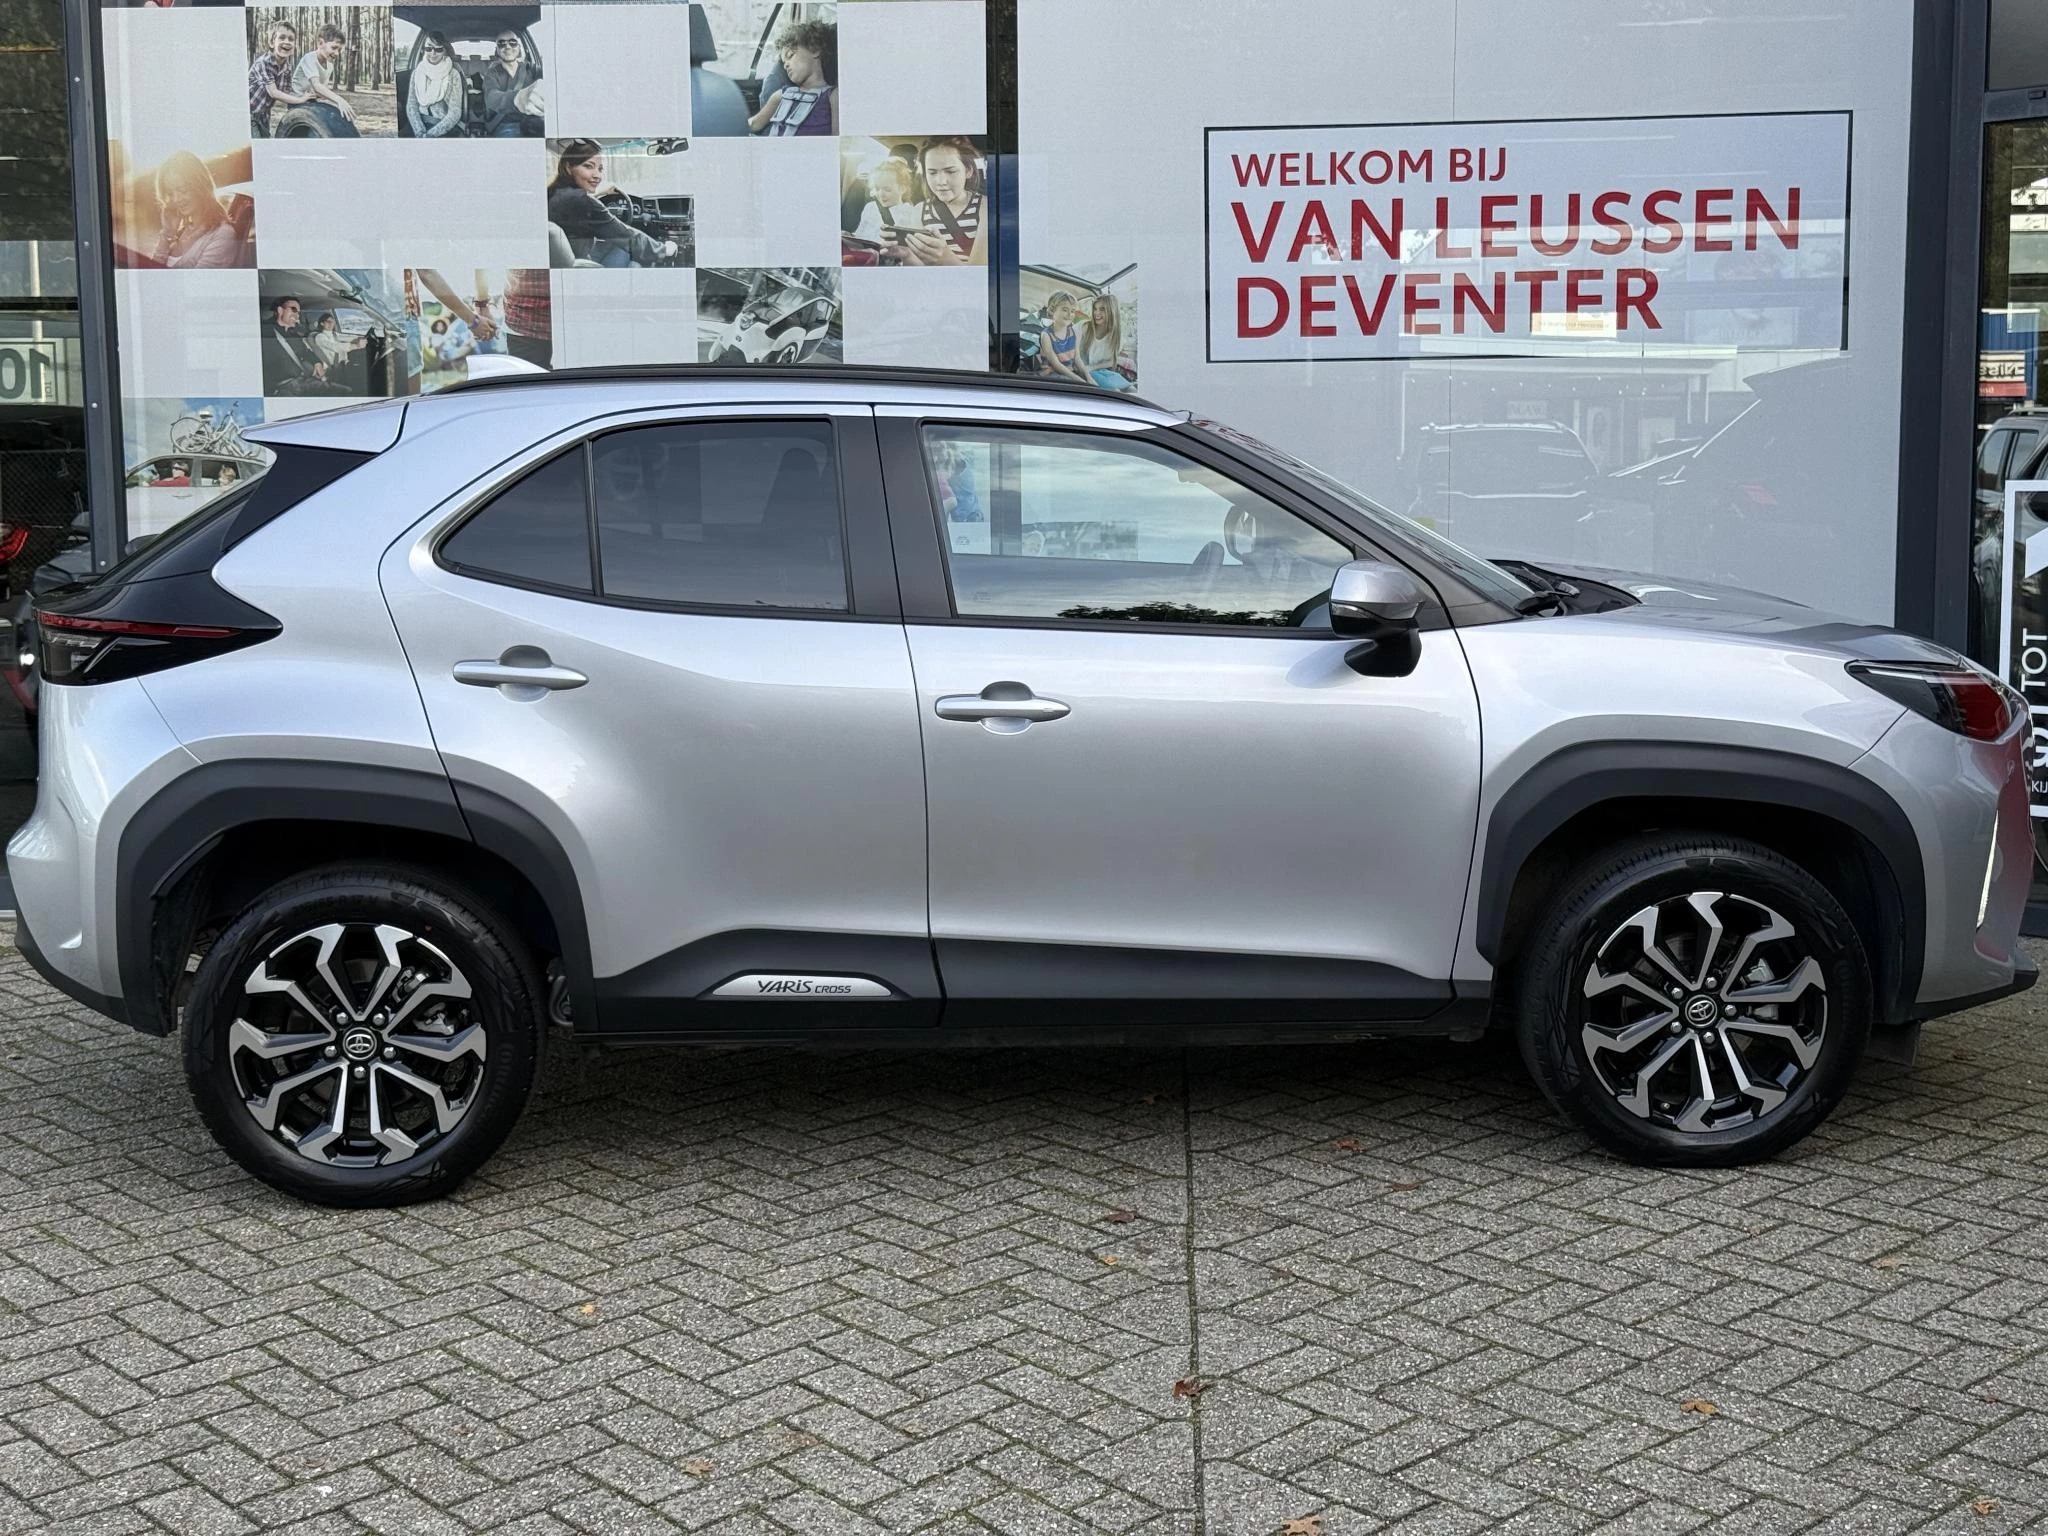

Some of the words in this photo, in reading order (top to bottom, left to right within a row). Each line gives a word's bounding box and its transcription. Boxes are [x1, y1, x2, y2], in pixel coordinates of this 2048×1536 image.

[1232, 148, 1433, 187] WELKOM
[1449, 147, 1506, 182] BIJ
[1231, 198, 1404, 263] VAN
[1435, 187, 1801, 257] LEUSSEN
[1236, 267, 1660, 338] DEVENTER
[2020, 627, 2048, 692] TOT
[814, 985, 852, 994] CROSS
